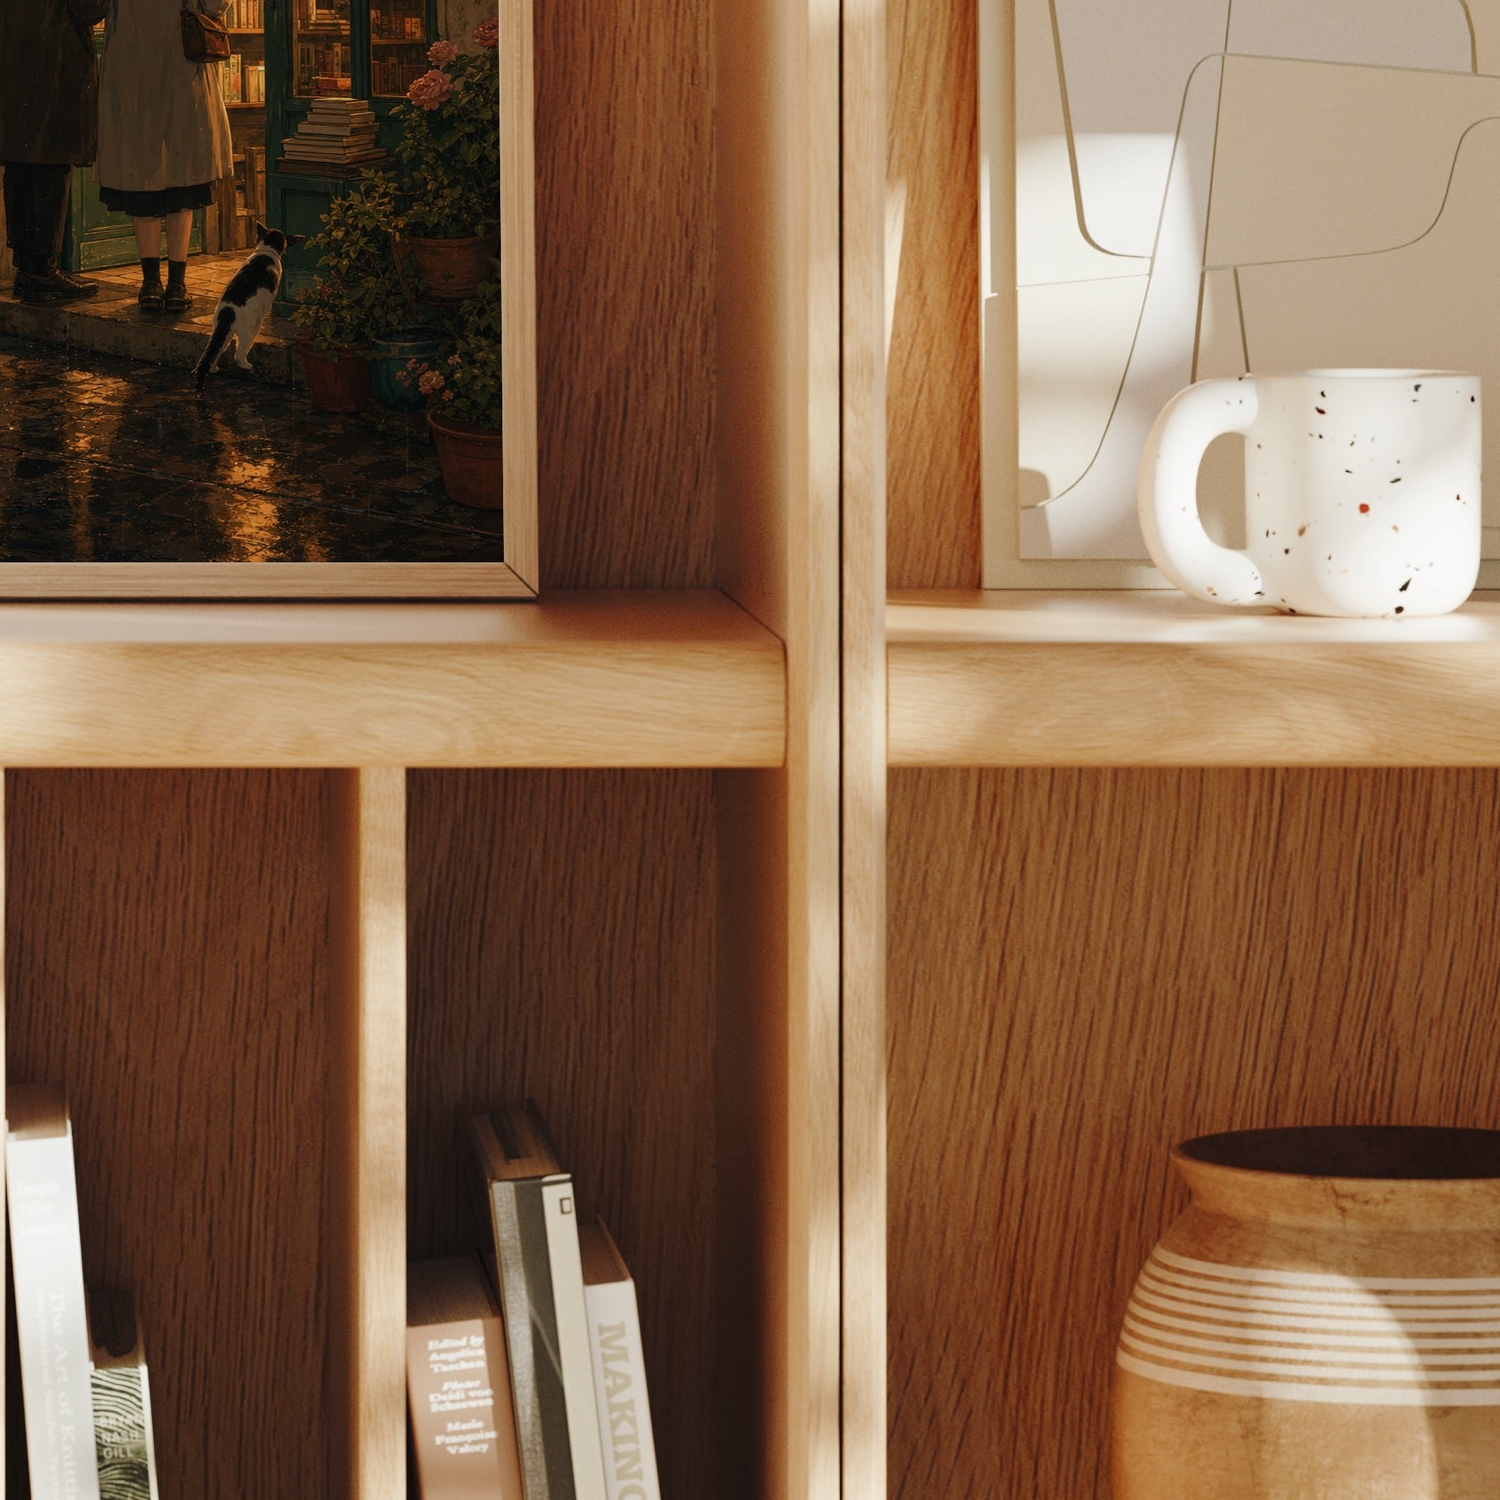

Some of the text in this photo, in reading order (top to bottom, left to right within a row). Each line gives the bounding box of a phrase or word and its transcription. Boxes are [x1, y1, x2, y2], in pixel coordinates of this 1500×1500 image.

[51, 1286, 66, 1336] The
[54, 1340, 69, 1384] Art
[58, 1389, 75, 1419] of
[103, 1446, 133, 1459] GILL
